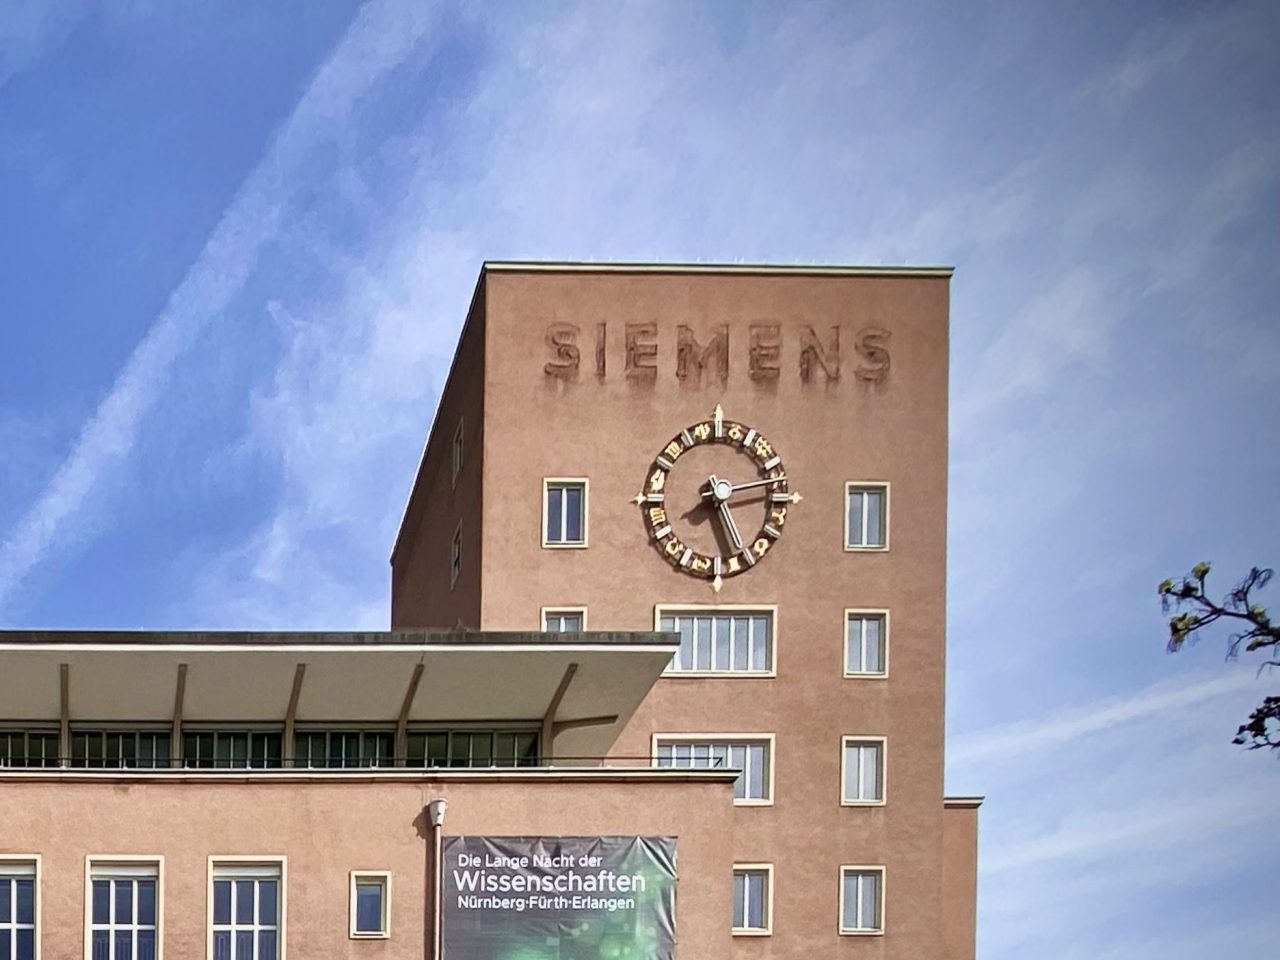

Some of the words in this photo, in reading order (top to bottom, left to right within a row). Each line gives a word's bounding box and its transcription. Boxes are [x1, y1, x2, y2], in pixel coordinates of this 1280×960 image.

[544, 322, 892, 382] SIEMENS
[458, 854, 483, 867] Die
[485, 854, 529, 869] Lange
[533, 854, 575, 867] Nacht
[578, 854, 603, 867] der
[453, 870, 646, 892] Wissenschaften
